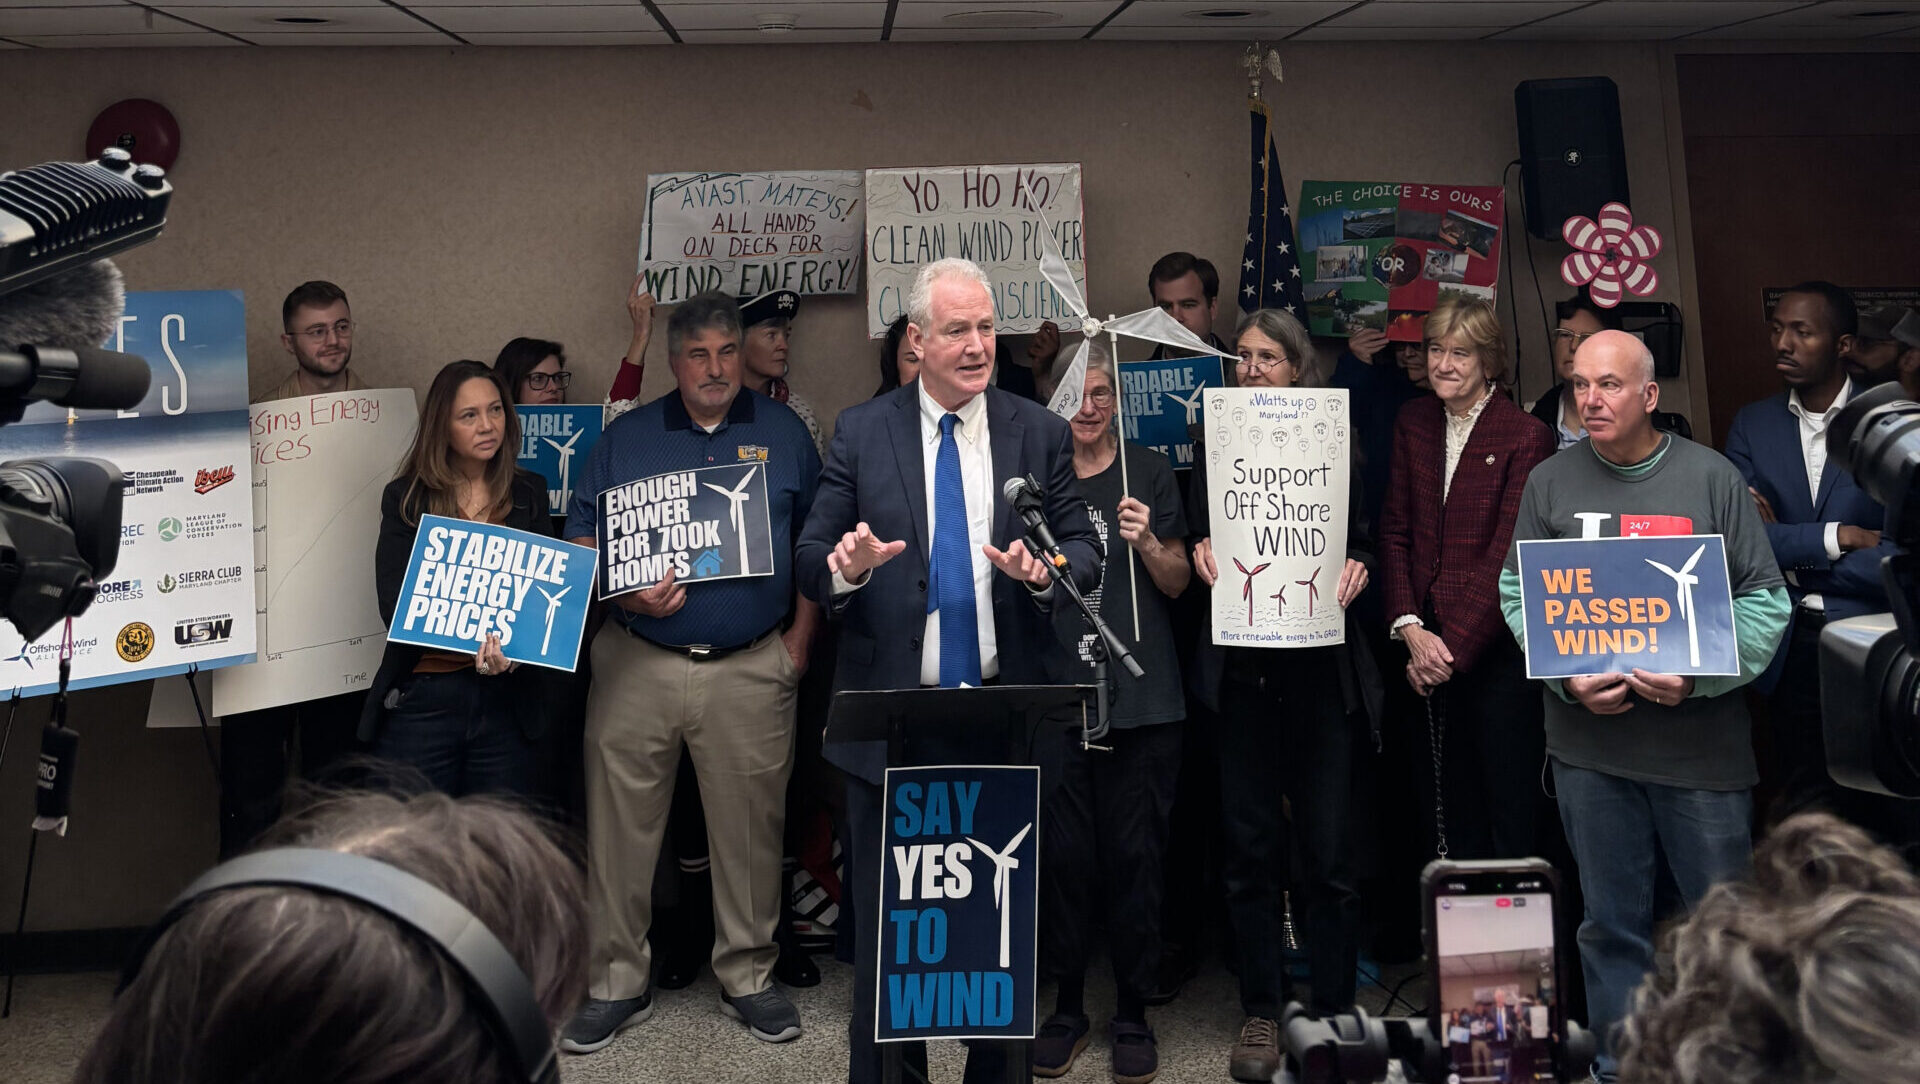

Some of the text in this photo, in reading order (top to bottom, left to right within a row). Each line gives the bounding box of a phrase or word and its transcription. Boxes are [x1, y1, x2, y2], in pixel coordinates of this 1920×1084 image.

[681, 180, 753, 210] AVAST,
[760, 182, 858, 222] MATEYS!
[903, 167, 1065, 214] YO HO HO!
[1312, 184, 1493, 212] THE CHOICE IS OURS
[711, 212, 816, 234] ALL HANDS
[684, 235, 823, 257] ON DECK FOR
[872, 222, 945, 264] CLEAN
[957, 220, 1013, 262] WIND
[1381, 256, 1405, 272] OR
[644, 255, 859, 302] WIND ENERGY!
[992, 277, 1084, 321] NSCIENC
[1120, 367, 1195, 394] RDABLE
[311, 396, 380, 425] Energy
[1121, 392, 1164, 417] ABLE
[1259, 410, 1309, 422] Maryland ??
[1291, 398, 1304, 410] up
[518, 413, 574, 437] DABLE
[251, 434, 311, 464] ices
[136, 469, 177, 480] Chesapeake
[136, 476, 184, 487] Climate Action
[1233, 458, 1331, 492] Support
[136, 485, 163, 494] Network
[606, 472, 698, 516] ENOUGH
[186, 512, 226, 521] MARYLAND
[606, 499, 690, 540] POWER
[1224, 490, 1330, 522] Off Shore
[186, 520, 214, 528] LEAGUE
[186, 523, 242, 534] CONSERVATION
[186, 531, 214, 539] VOTERS
[1629, 521, 1651, 530] 24/7
[607, 519, 722, 566] FOR 700K
[1253, 526, 1326, 557] WIND
[423, 526, 570, 586] STABILIZE
[179, 566, 242, 584] SIERRA CLUB
[179, 577, 242, 589] MARYLAND CHAPTER
[608, 551, 691, 592] HOMES
[1541, 568, 1594, 594] WE
[95, 590, 144, 604] OGRESS
[413, 560, 534, 611] ENERGY
[403, 594, 516, 646] PRICES
[1544, 597, 1671, 625] PASSED
[174, 619, 233, 645] USW
[1220, 630, 1240, 641] More
[1242, 631, 1282, 641] renewable
[1286, 634, 1307, 643] energy
[1552, 628, 1659, 655] WIND!
[29, 637, 97, 655] Offshoe Wind
[36, 647, 93, 660] ALLANCE
[343, 672, 367, 684] Time
[894, 781, 982, 838] SAY
[892, 842, 973, 900] YES
[890, 907, 948, 965] TO
[888, 971, 1014, 1030] WIND
